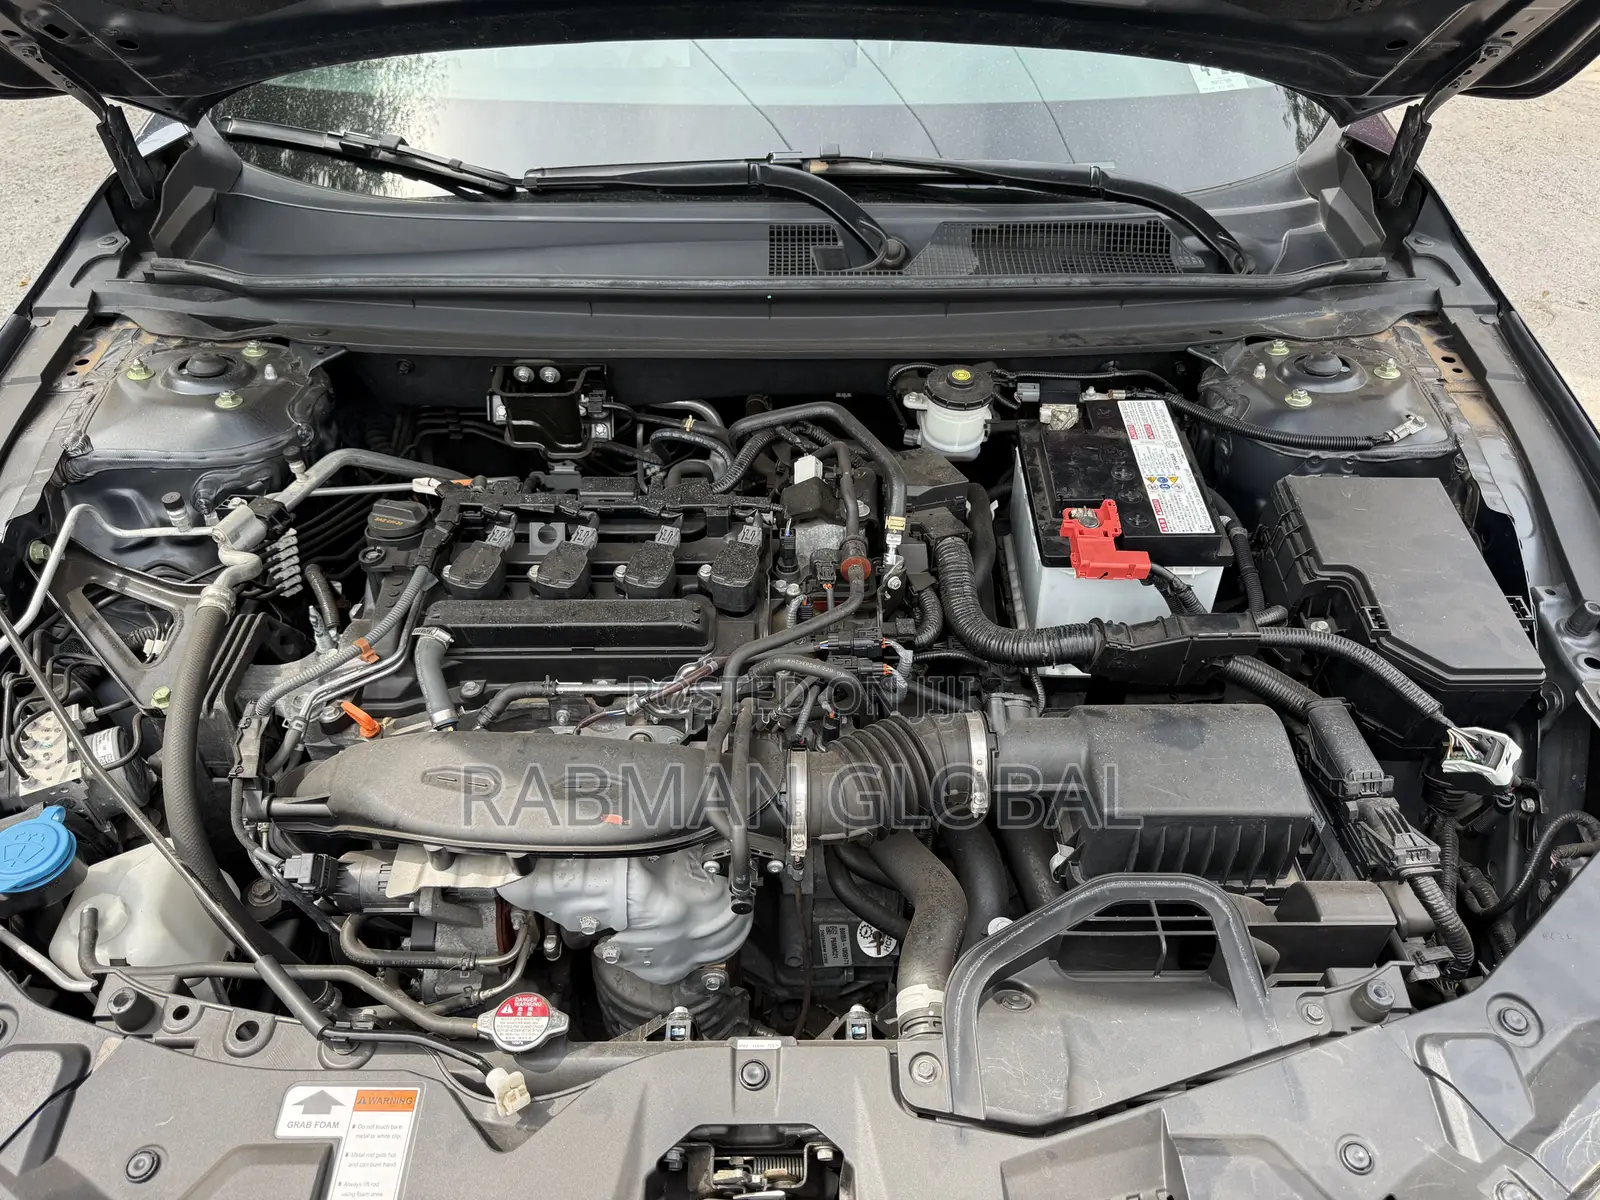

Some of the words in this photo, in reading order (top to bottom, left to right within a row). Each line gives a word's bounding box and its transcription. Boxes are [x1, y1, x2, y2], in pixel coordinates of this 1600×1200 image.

[368, 1096, 413, 1105] WARNING
[286, 1120, 312, 1129] GRAB
[313, 1120, 340, 1129] FOAM
[342, 1181, 362, 1189] Always
